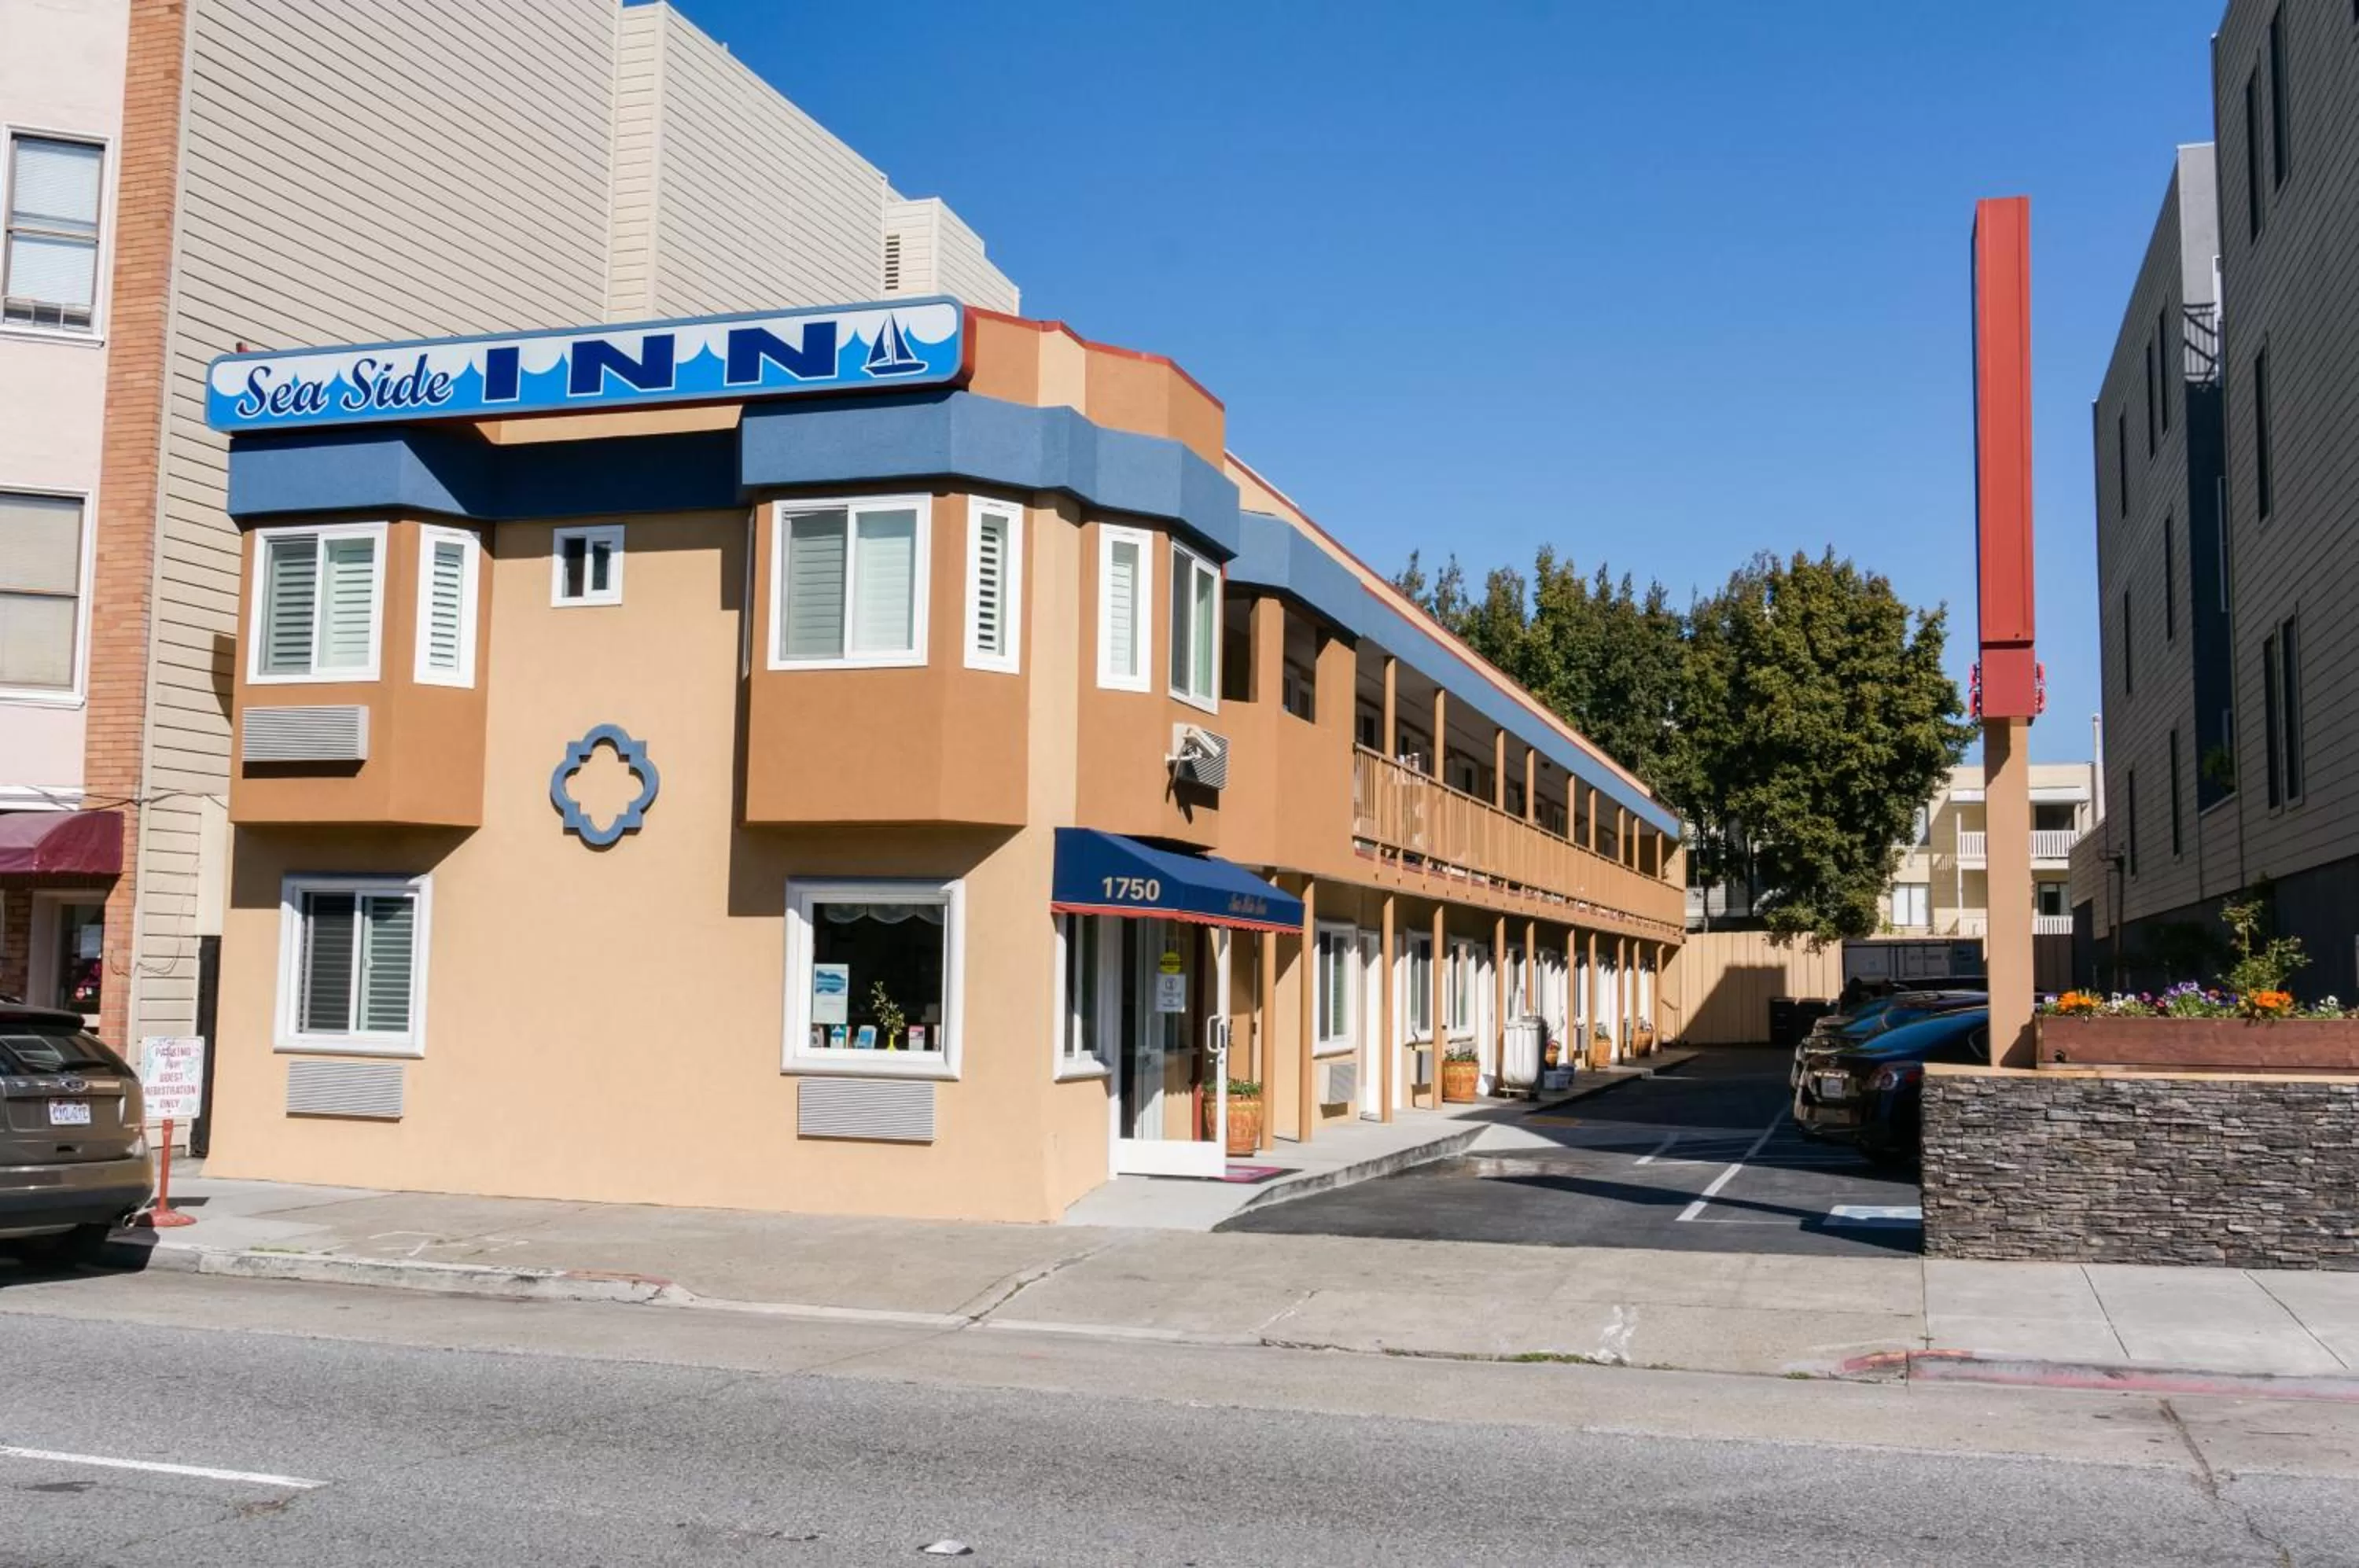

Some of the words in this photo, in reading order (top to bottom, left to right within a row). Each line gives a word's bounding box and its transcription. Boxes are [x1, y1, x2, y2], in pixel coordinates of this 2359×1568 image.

[237, 365, 328, 417] Sea
[341, 353, 452, 410] Side
[484, 321, 837, 402] INN
[1102, 876, 1161, 901] 1750
[160, 1099, 180, 1109] ONLY
